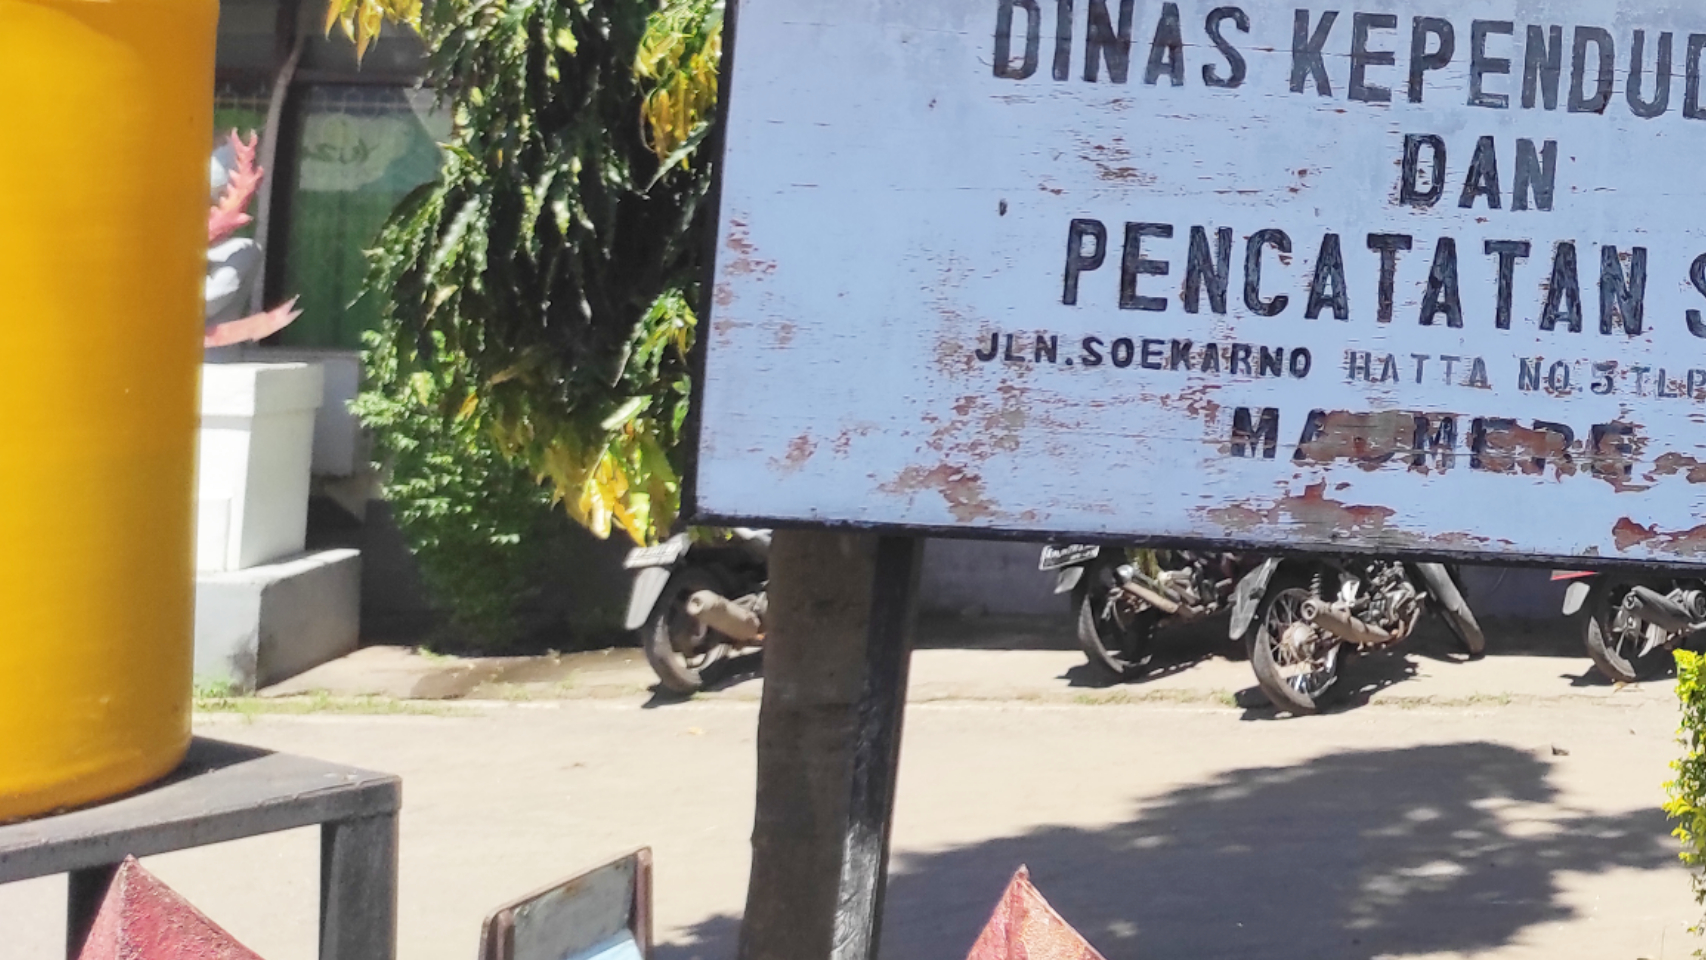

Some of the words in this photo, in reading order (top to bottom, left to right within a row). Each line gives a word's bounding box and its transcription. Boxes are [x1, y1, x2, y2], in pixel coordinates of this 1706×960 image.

[1400, 133, 1557, 211] DAN
[1062, 218, 1647, 337] PENCATATAN
[1348, 351, 1489, 389] HATTA
